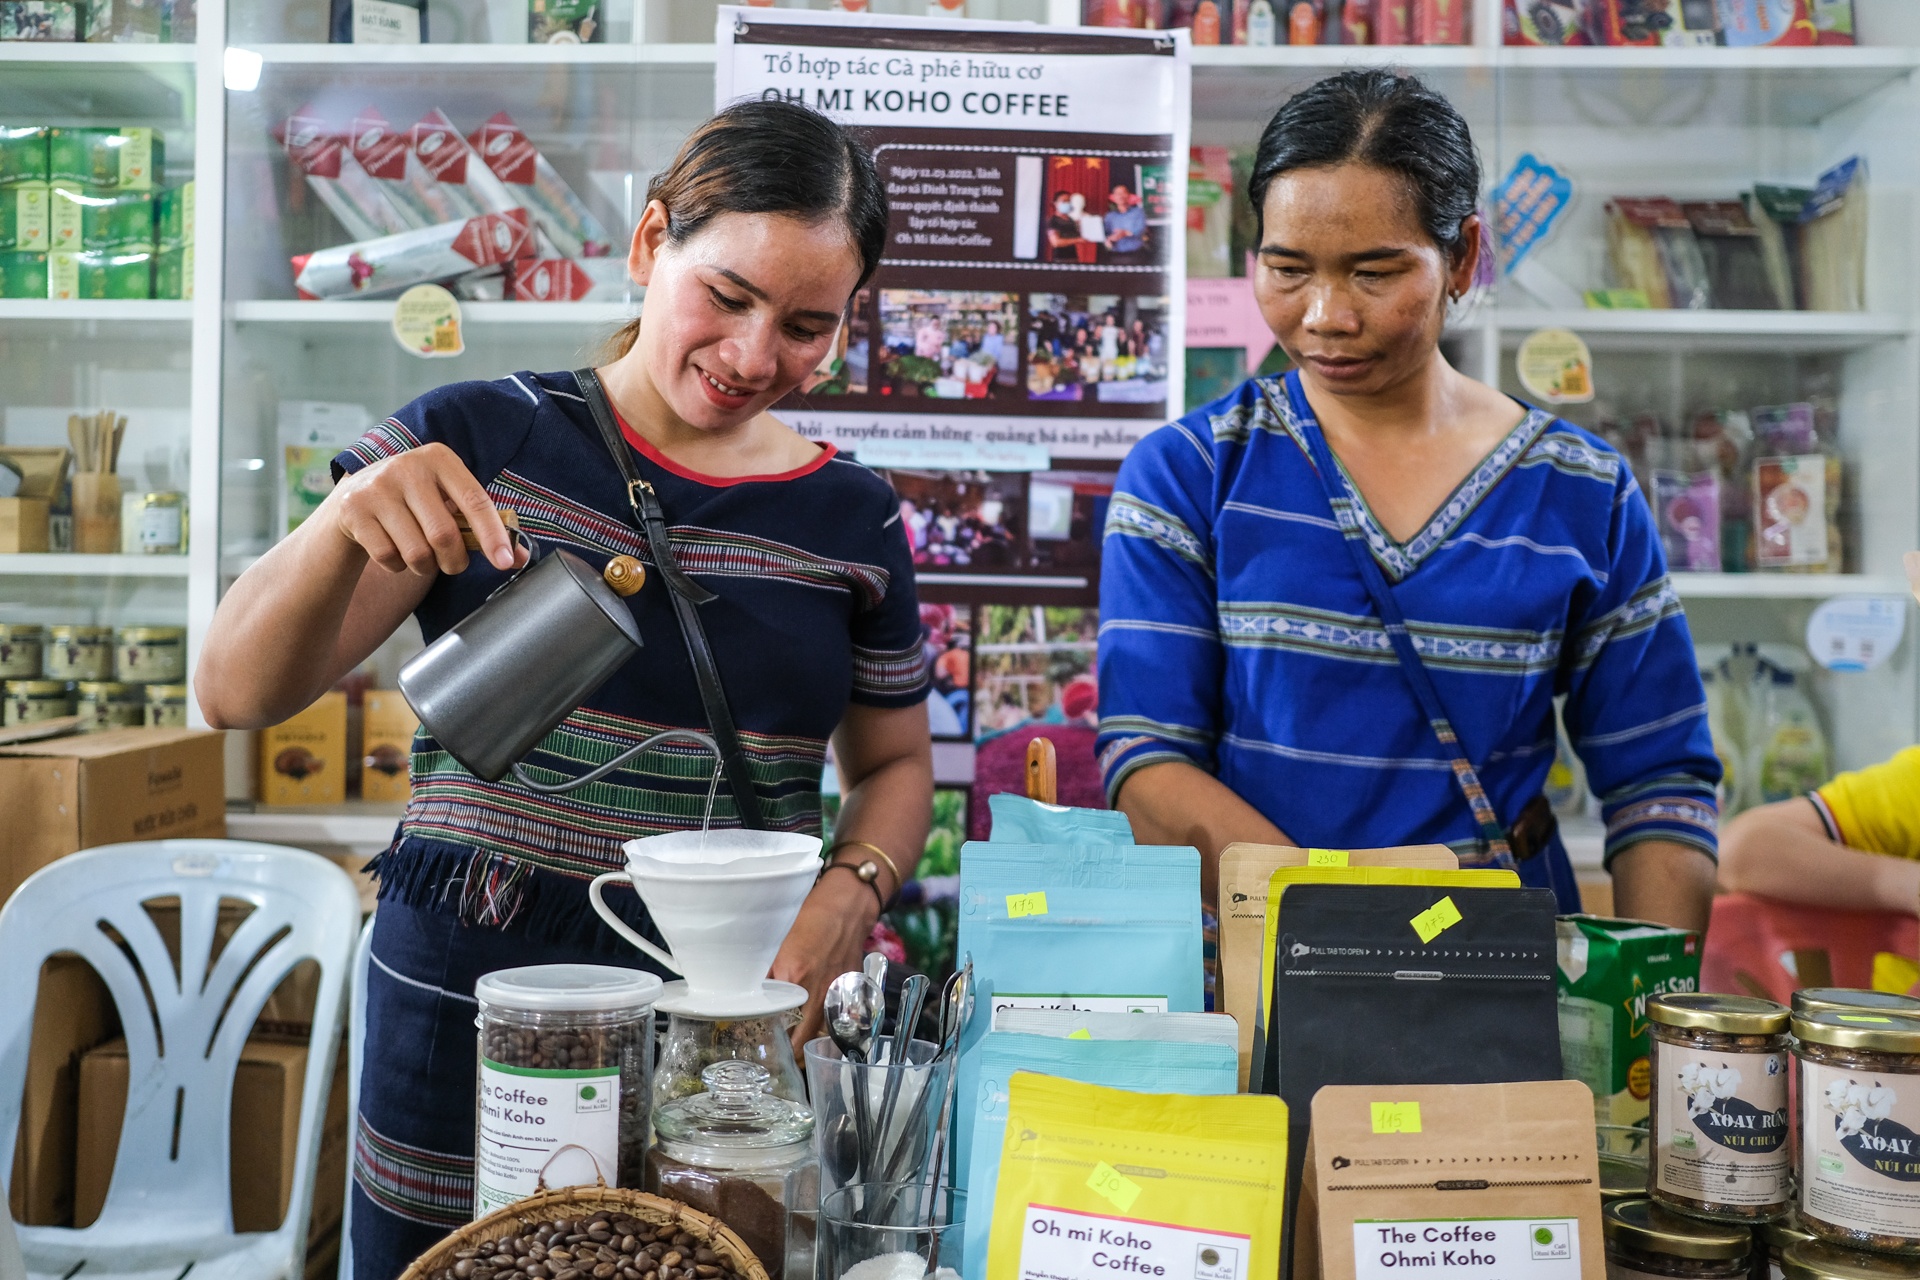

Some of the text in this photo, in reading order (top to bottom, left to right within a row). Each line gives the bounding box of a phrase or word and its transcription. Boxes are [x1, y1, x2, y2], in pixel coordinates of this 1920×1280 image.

[764, 52, 1043, 82] Tổ hợp tác Cà phê hữu cơ
[761, 87, 1069, 117] OH MI KOHO COFFEE
[893, 422, 927, 439] cảm
[985, 425, 1036, 444] quảng
[1039, 428, 1057, 443] bá
[1061, 427, 1089, 443] sản
[1012, 900, 1035, 912] 175
[1423, 913, 1445, 932] 175
[1311, 947, 1326, 955] PULL
[1669, 976, 1695, 993] Sao
[494, 1086, 548, 1106] Coffee
[504, 1108, 545, 1125] Koho
[1377, 1109, 1402, 1129] 115
[1710, 1112, 1756, 1129] XOAY
[1723, 1134, 1746, 1146] NÚI
[1860, 1134, 1913, 1154] XOAY
[1874, 1159, 1900, 1173] NÚI
[1031, 1218, 1153, 1250] Oh mi Koho
[1378, 1226, 1497, 1244] The Coffee
[1092, 1251, 1166, 1276] Coffee
[1380, 1249, 1496, 1268] Ohmi Koho
